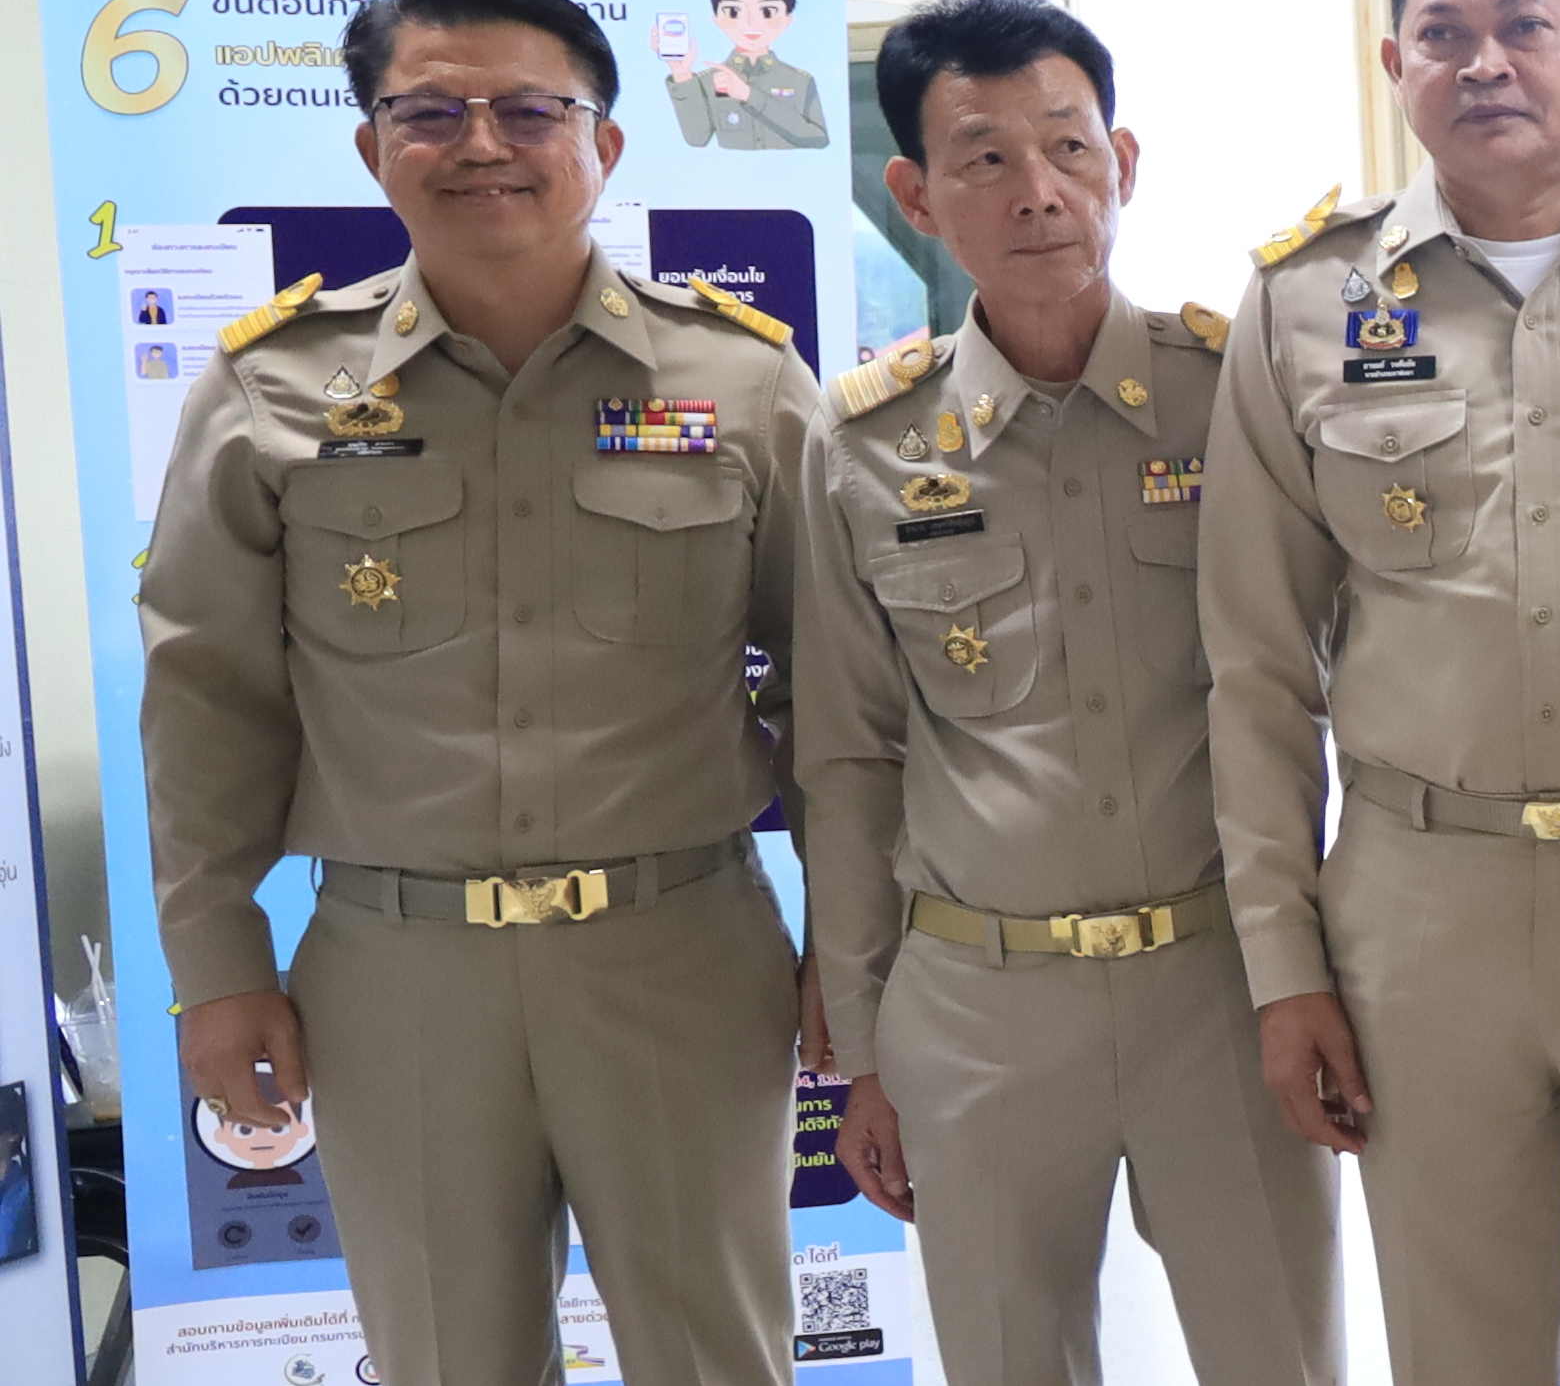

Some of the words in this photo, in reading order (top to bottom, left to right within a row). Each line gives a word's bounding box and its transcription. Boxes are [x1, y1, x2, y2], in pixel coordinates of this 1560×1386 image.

[87, 200, 123, 259] 1
[818, 1340, 857, 1354] Google
[859, 1337, 881, 1352] play
